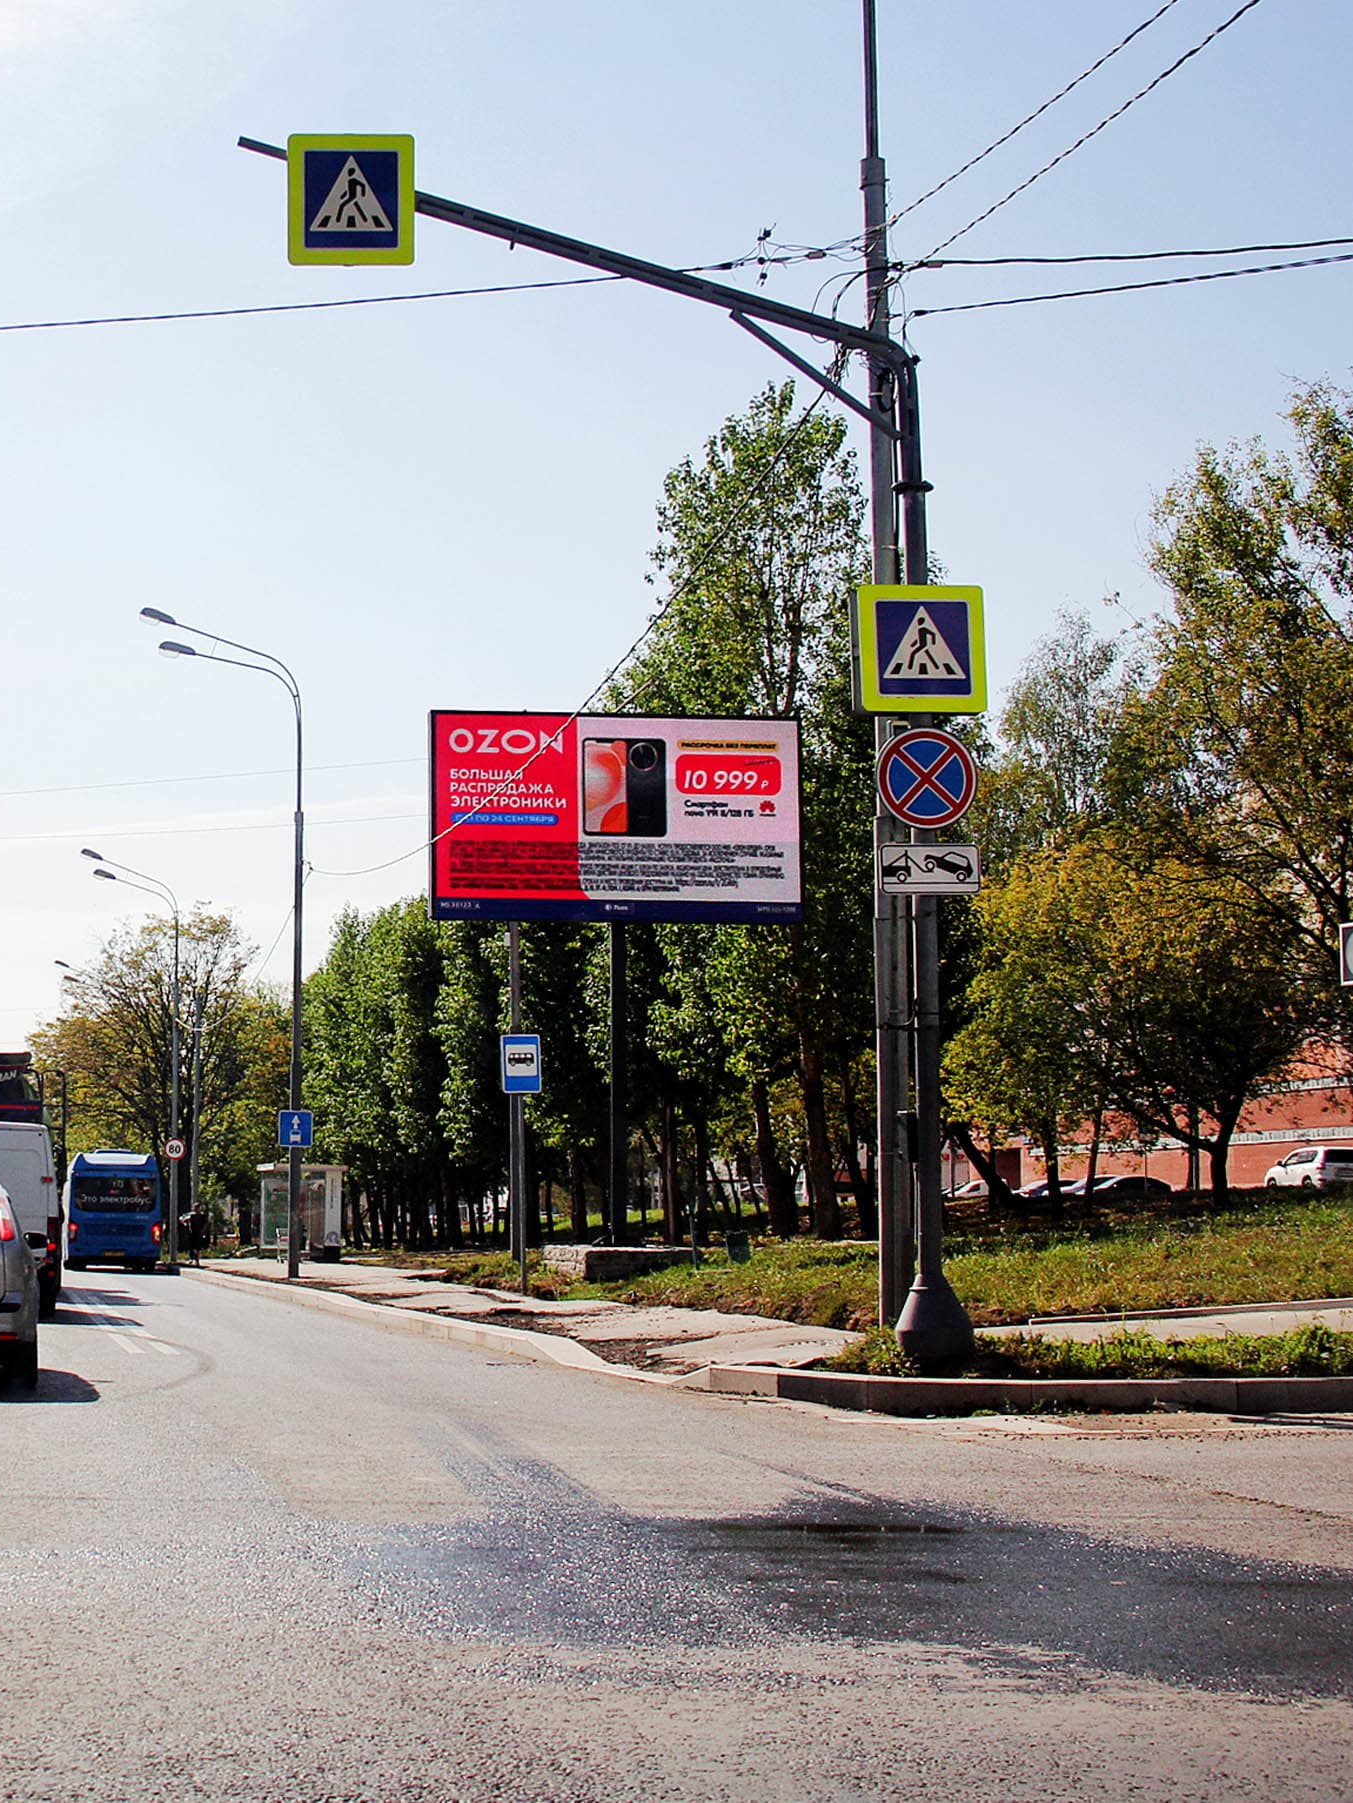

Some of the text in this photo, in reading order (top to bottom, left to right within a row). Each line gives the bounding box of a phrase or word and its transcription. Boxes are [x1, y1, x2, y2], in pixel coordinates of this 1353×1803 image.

[449, 728, 563, 754] OZON
[450, 768, 524, 781] БОЛЬШАЯ
[684, 770, 708, 790] 10
[713, 770, 759, 791] 999
[450, 782, 554, 795] РАСПРОДАЖА
[450, 795, 567, 809] ЭЛЕКТРОНИКИ
[168, 1144, 182, 1154] 80
[81, 1193, 97, 1204] Это
